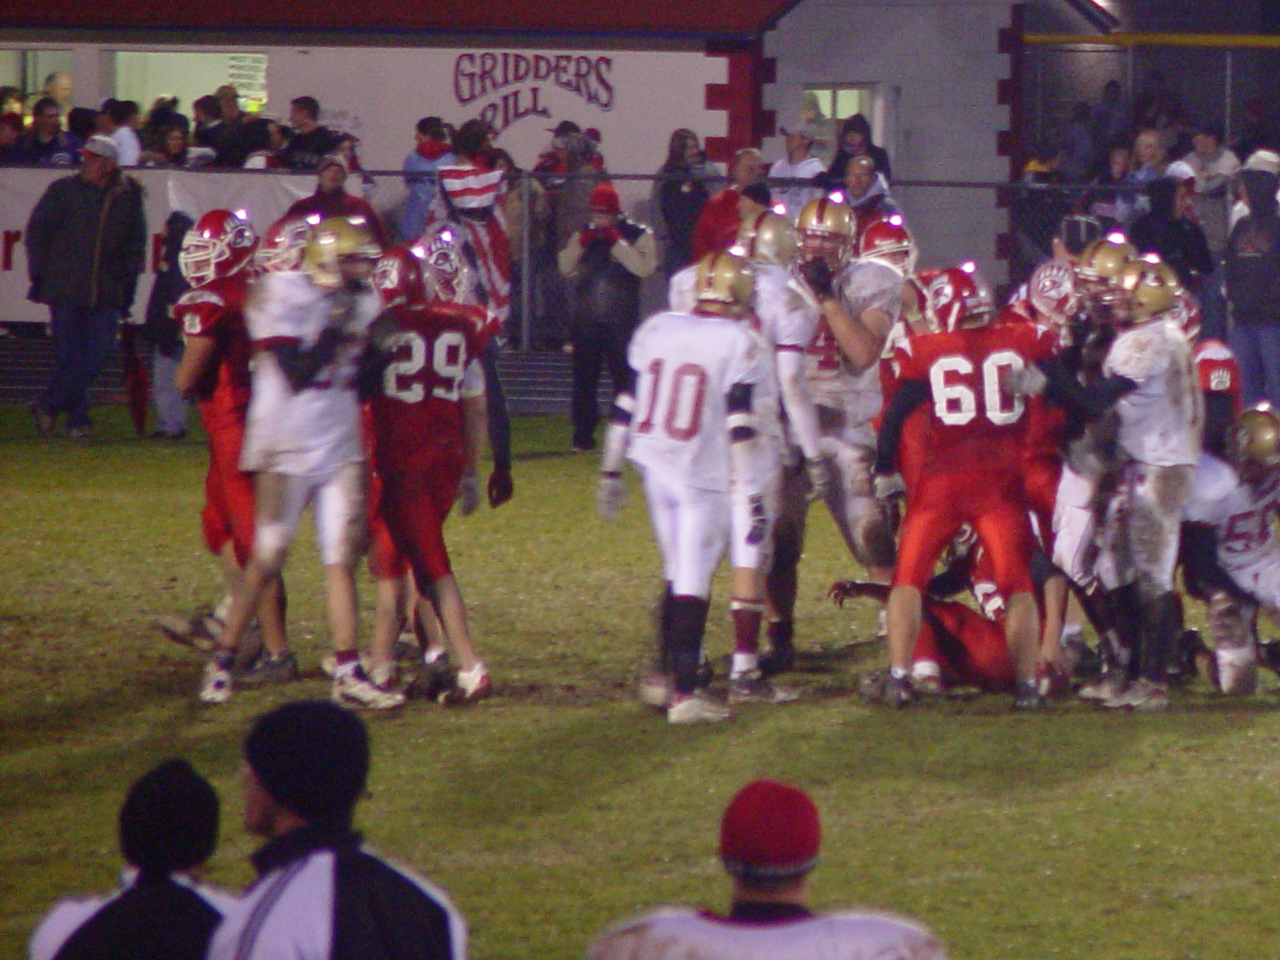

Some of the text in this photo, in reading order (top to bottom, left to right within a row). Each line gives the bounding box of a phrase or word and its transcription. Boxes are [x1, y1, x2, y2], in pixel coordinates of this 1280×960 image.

[454, 52, 614, 111] GRIDDERS
[479, 87, 553, 136] RILL
[382, 331, 467, 403] 29
[637, 357, 708, 442] 10
[929, 350, 1026, 426] 60
